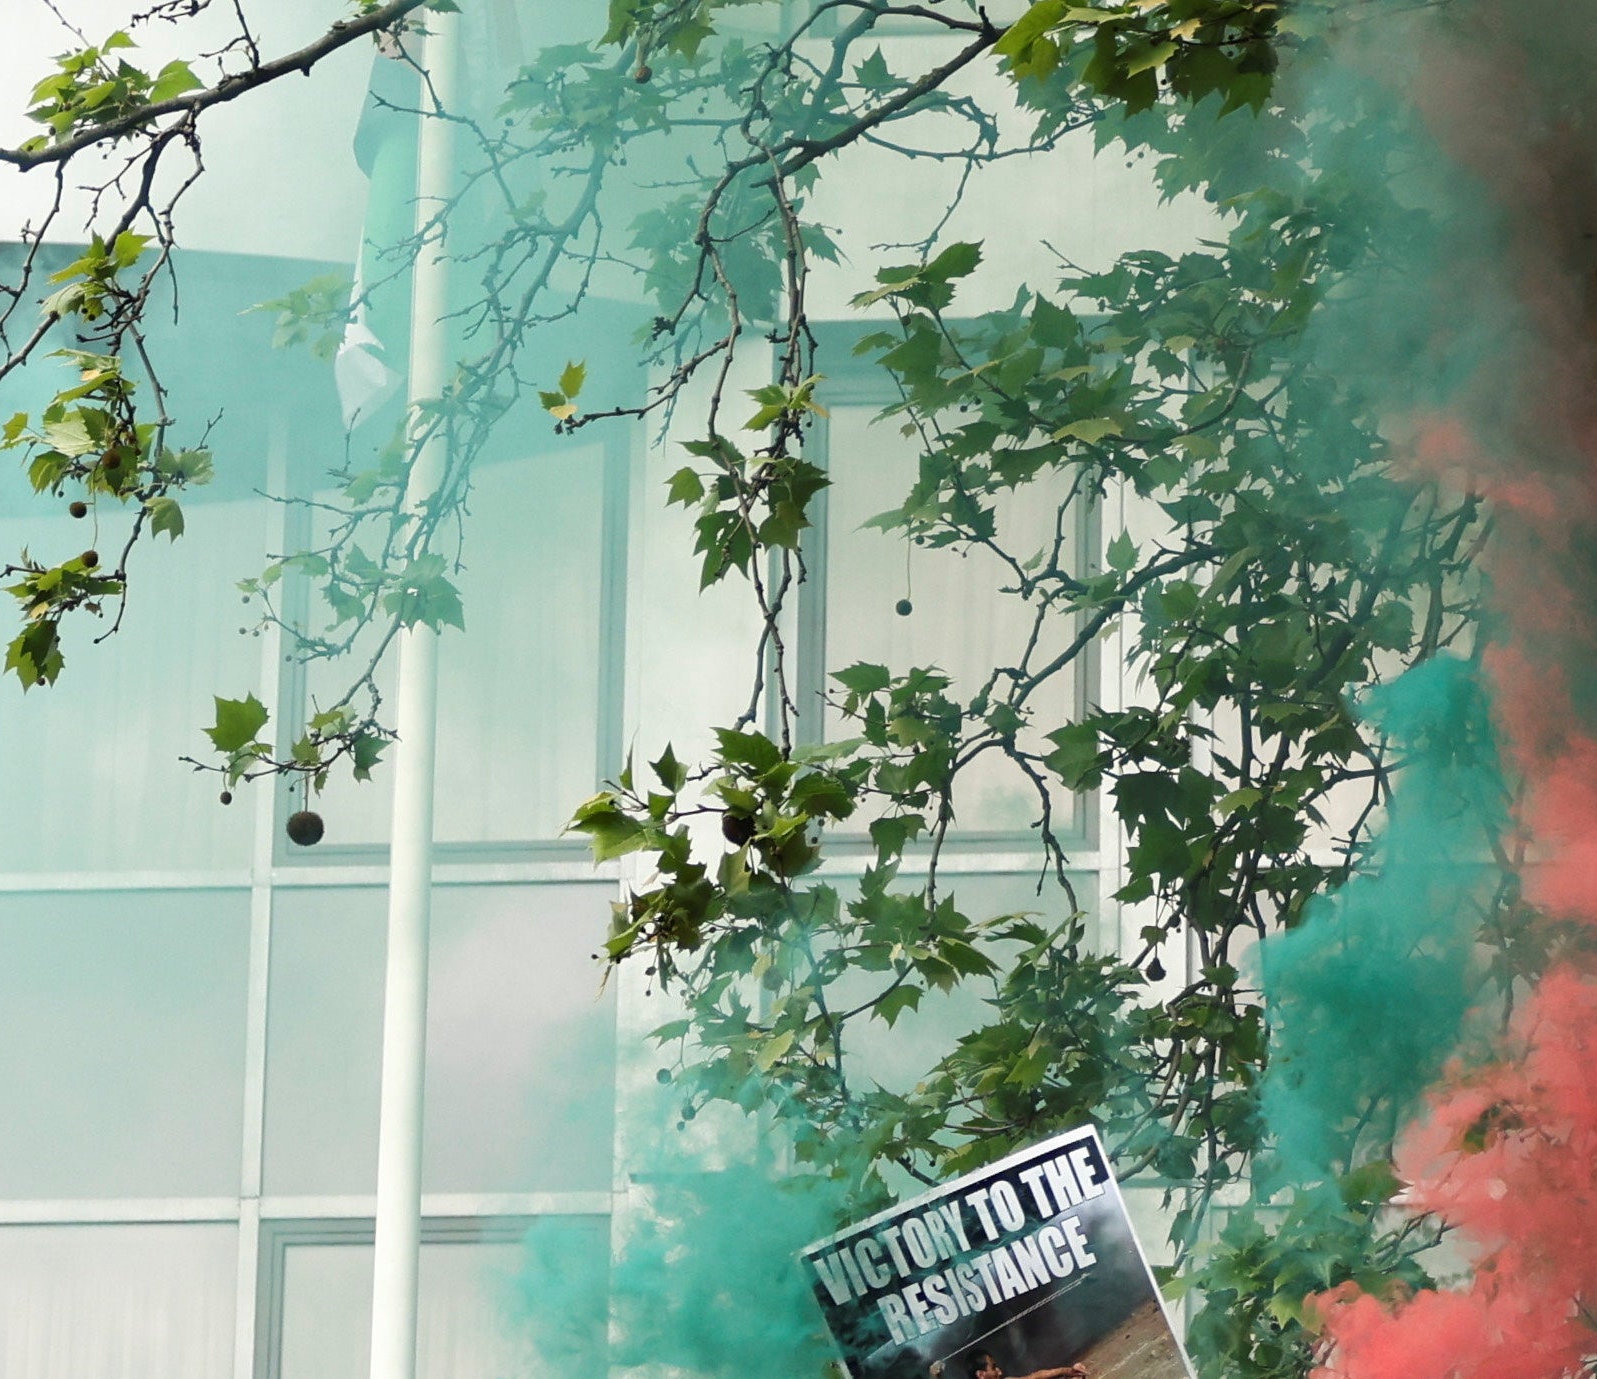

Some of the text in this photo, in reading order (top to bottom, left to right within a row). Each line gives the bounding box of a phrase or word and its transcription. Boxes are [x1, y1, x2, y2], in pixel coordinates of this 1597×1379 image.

[813, 1146, 1106, 1307] VICTORY TO THE
[877, 1215, 1096, 1346] RESISTANCE
